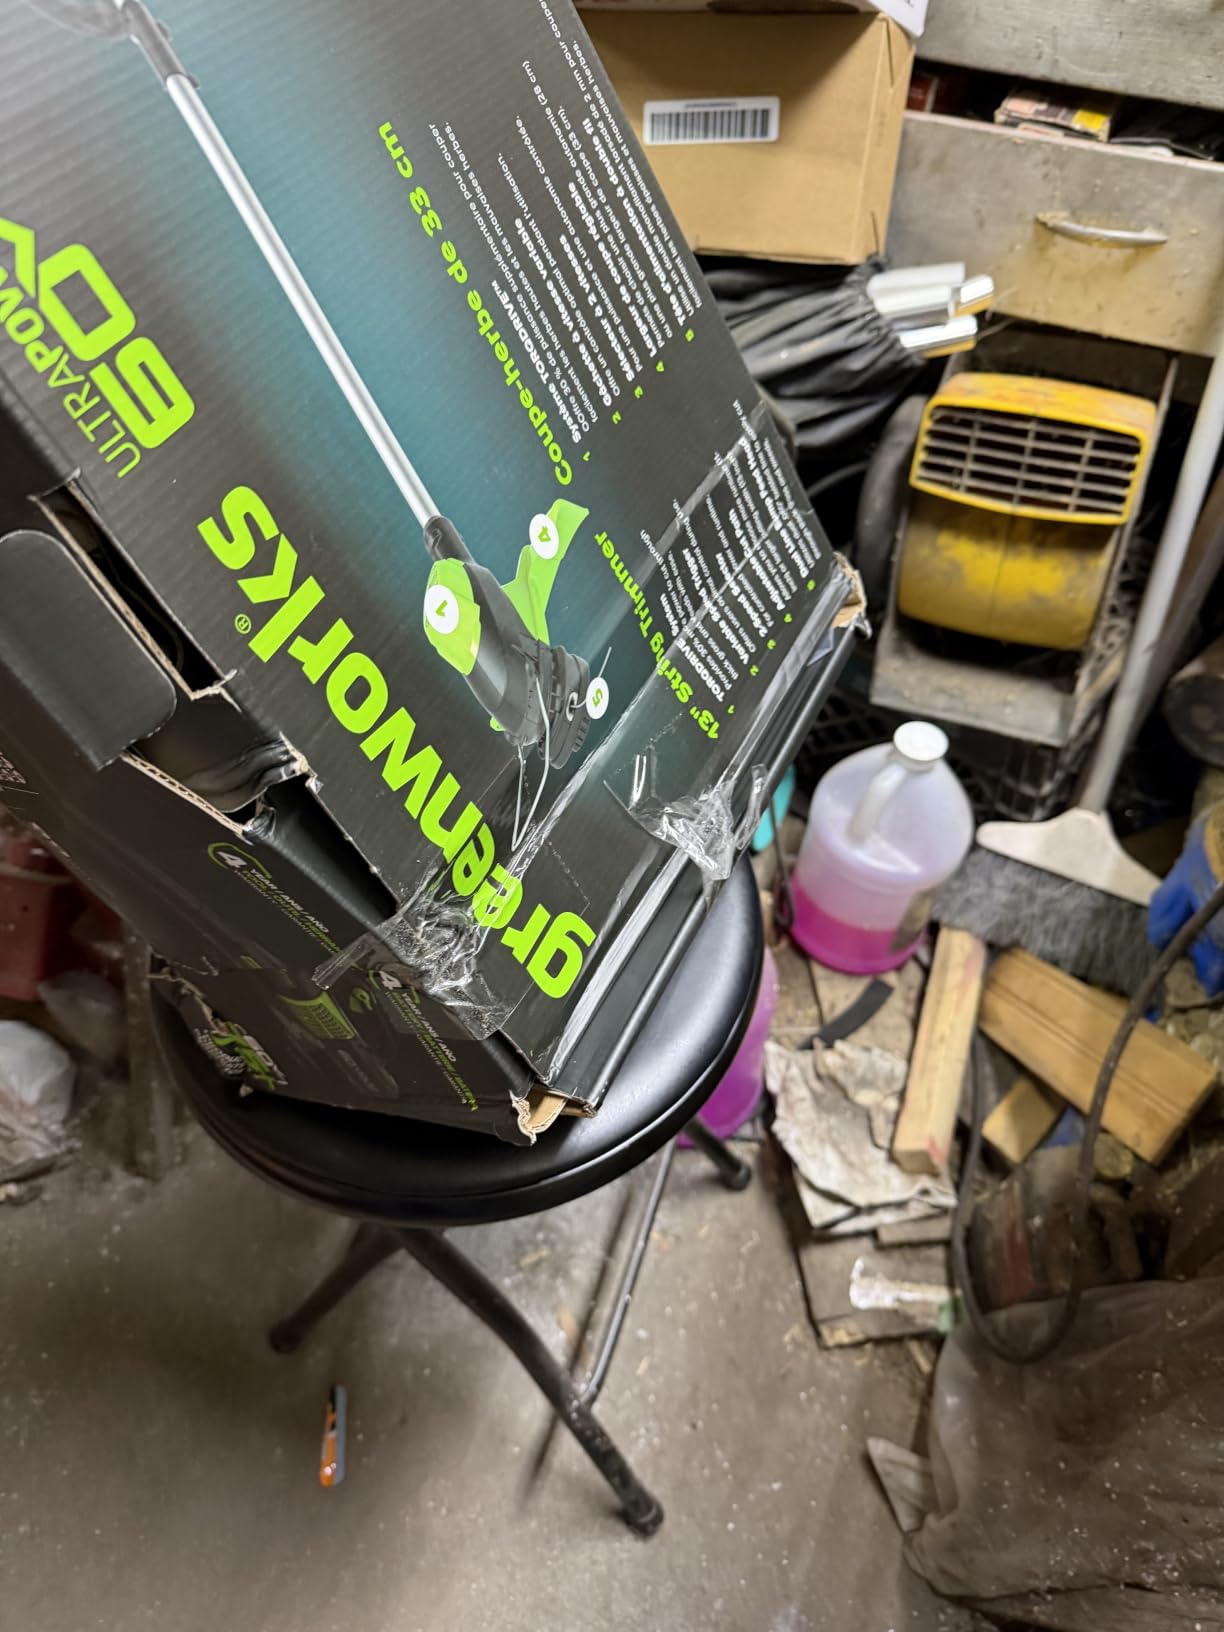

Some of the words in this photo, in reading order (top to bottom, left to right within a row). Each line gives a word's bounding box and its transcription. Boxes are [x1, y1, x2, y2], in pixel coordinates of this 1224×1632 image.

[538, 0, 562, 38] coupe
[522, 60, 536, 83] cm)
[559, 41, 576, 68] pour
[533, 85, 548, 105] (28
[573, 69, 587, 91] mm
[557, 105, 571, 130] cm).
[589, 103, 600, 119] de
[592, 84, 623, 143] mauvaises
[379, 122, 413, 178] cm
[428, 124, 455, 168] couper
[516, 115, 545, 174] contrôlée.
[545, 107, 577, 168] autonomie
[568, 131, 582, 151] (33
[596, 120, 620, 163] torsadé
[620, 143, 630, 156] et
[579, 152, 598, 187] coupe
[592, 135, 619, 185] double
[452, 171, 472, 200] pour
[575, 169, 598, 209] grande
[596, 188, 607, 203] de
[618, 163, 655, 234] monofilament
[409, 187, 442, 237] 33
[468, 172, 503, 236] mauvaises
[544, 176, 575, 235] autonomie
[568, 182, 600, 241] réglable
[595, 209, 610, 234] plus
[604, 205, 626, 243] largeur
[650, 204, 670, 241] herbes
[469, 202, 518, 292] supplémentaire
[501, 237, 513, 257] les
[515, 218, 547, 280] variable
[529, 219, 557, 267] pendant
[574, 236, 587, 258] une
[607, 234, 620, 255] une
[653, 234, 673, 270] double
[668, 240, 678, 258] les
[441, 241, 467, 283] de
[510, 256, 520, 270] et
[559, 234, 590, 293] vitesses
[584, 258, 593, 271] et
[598, 242, 621, 284] coupe
[617, 256, 637, 290] choisir
[624, 243, 646, 280] grande
[670, 269, 680, 285] un
[518, 270, 541, 311] hautes
[553, 267, 577, 309] optimal
[591, 272, 621, 324] puissance
[619, 285, 631, 304] de
[635, 290, 645, 305] de
[642, 280, 657, 303] plus
[675, 256, 702, 308] facilement
[546, 280, 574, 331] vitesse
[653, 303, 666, 324] une
[677, 285, 694, 316] Utilise
[516, 294, 549, 350] puissance
[539, 310, 561, 350] herbes
[618, 325, 631, 346] une
[628, 305, 657, 357] Largeur
[642, 305, 665, 348] Permets
[663, 323, 673, 338] ou
[546, 351, 556, 367] de
[559, 349, 570, 368] les
[579, 343, 612, 406] Gâchette
[597, 353, 607, 369] un
[628, 347, 643, 372] Pour
[467, 290, 572, 484] Coupe-herbe
[559, 379, 571, 396] 30
[568, 366, 598, 422] facilement
[605, 369, 620, 396] Offre
[548, 383, 581, 443] Système
[752, 468, 768, 499] Feed
[537, 525, 551, 542] 4
[729, 508, 743, 538] Path
[779, 528, 795, 553] Line
[739, 535, 753, 560] Cut
[791, 551, 809, 578] Dual
[596, 532, 652, 637] Trimmer
[682, 548, 702, 590] Trigger
[435, 600, 448, 617] 1
[660, 593, 679, 636] System
[719, 620, 749, 664] Variable
[650, 632, 693, 702] String
[592, 689, 604, 707] 5
[217, 851, 249, 869] 4
[379, 970, 403, 990] 4
